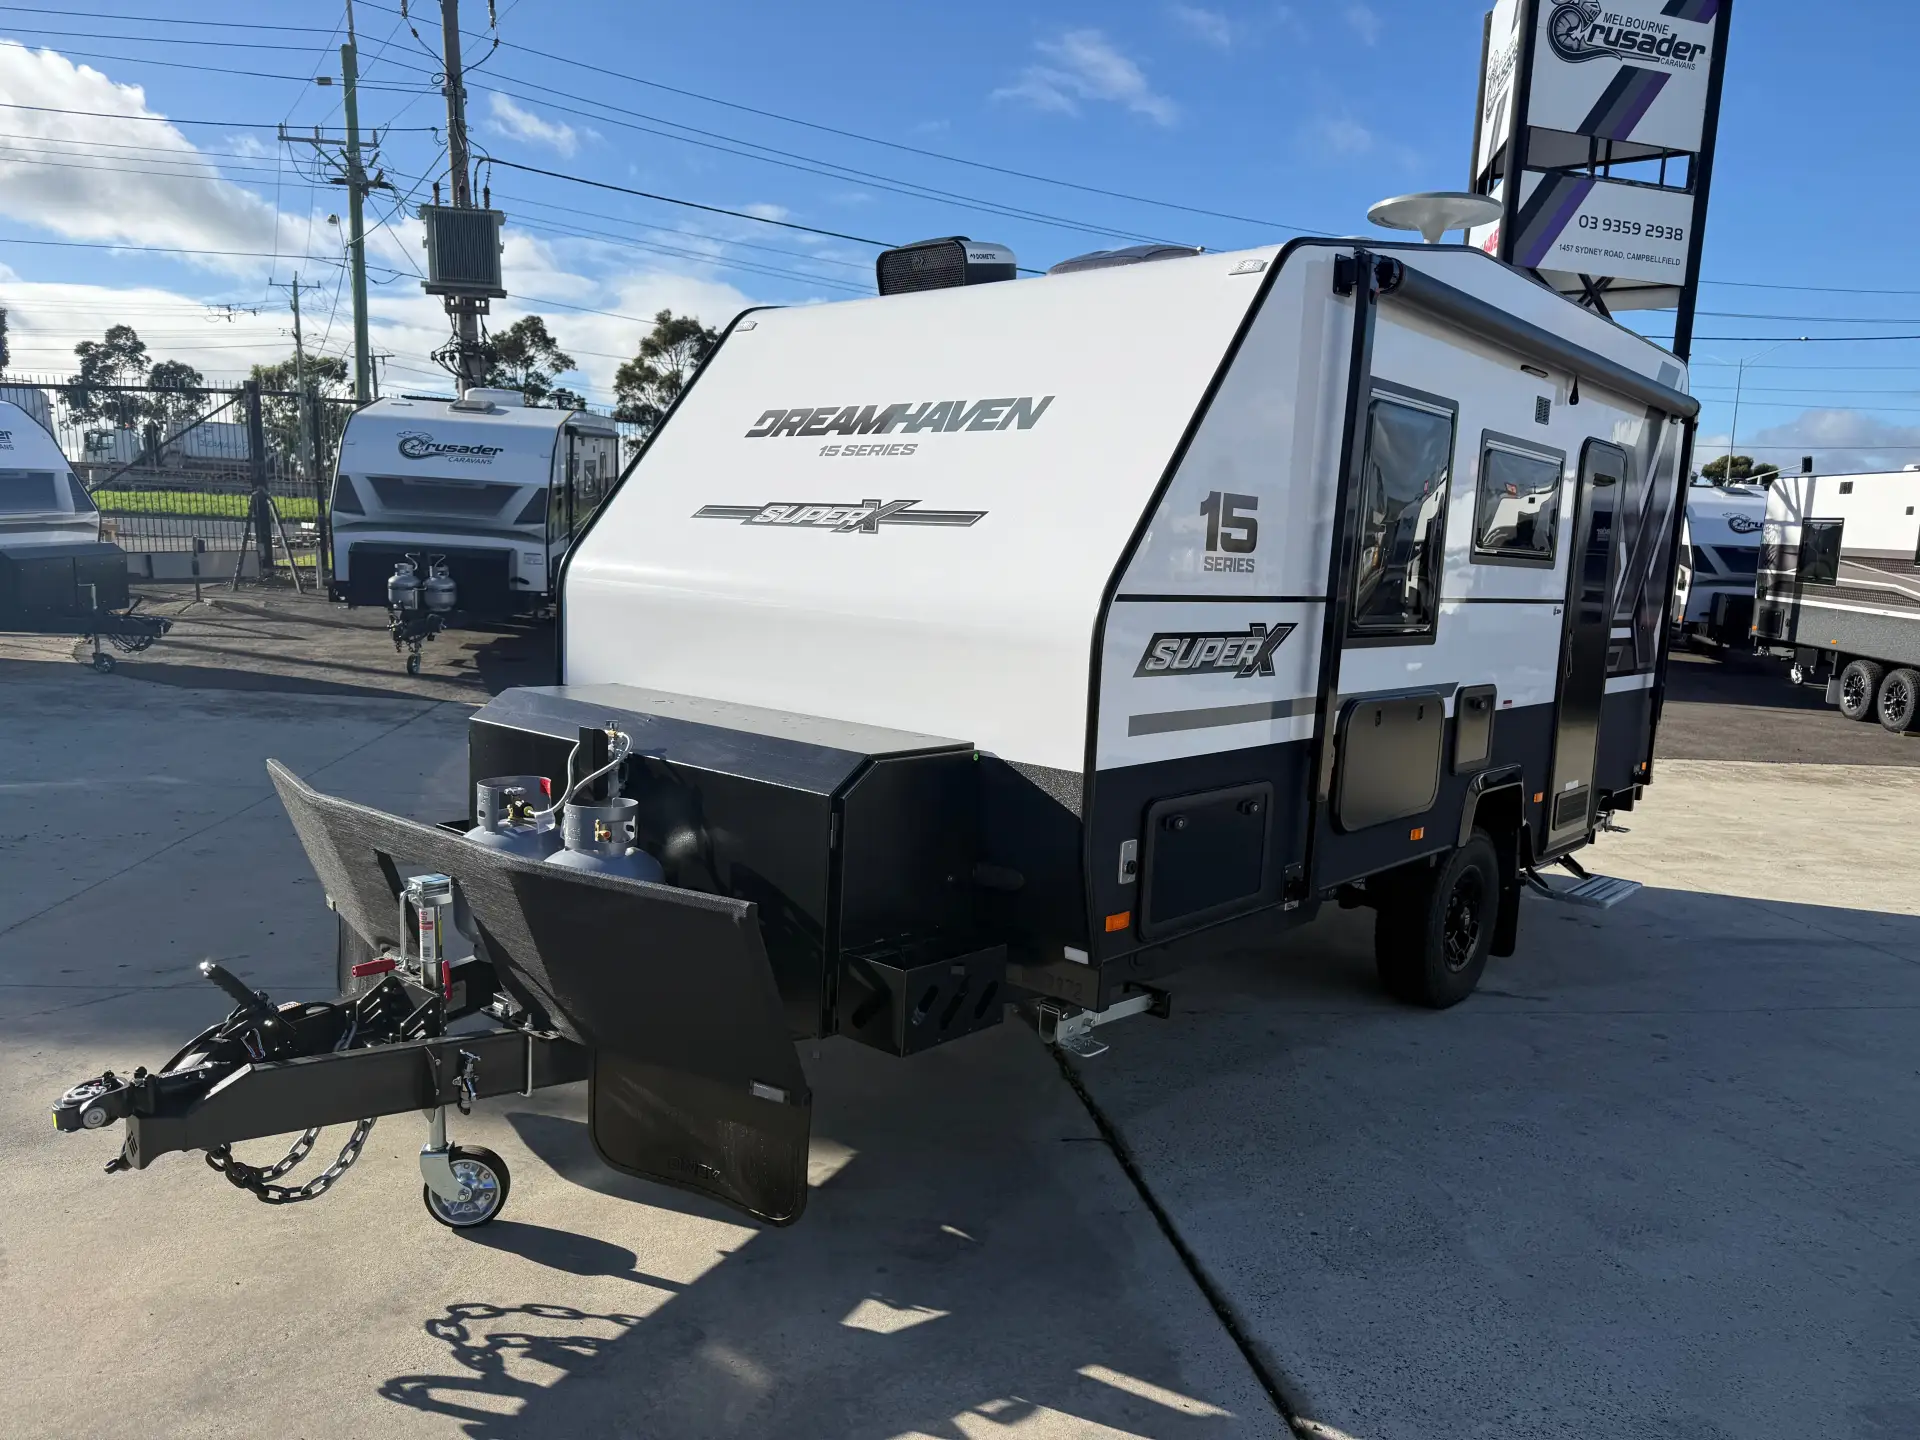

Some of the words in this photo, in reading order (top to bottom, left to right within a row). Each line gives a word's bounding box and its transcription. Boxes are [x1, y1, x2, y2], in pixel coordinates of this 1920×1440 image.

[1547, 3, 1706, 63] Crusader
[1603, 12, 1670, 36] MELBOURNE
[1660, 57, 1697, 71] CARAVANS
[1578, 214, 1599, 230] 03
[1602, 218, 1641, 236] 9359
[1645, 224, 1684, 241] 2938
[1558, 243, 1574, 252] 1457
[1575, 245, 1603, 256] SYDNEY
[1603, 249, 1625, 260] ROAD,
[1626, 252, 1681, 266] CAMPBELLFIELD
[744, 395, 1056, 438] DREAMHAVEN
[398, 436, 504, 460] Crusader
[819, 445, 842, 457] 15
[841, 443, 919, 457] SERIES
[448, 456, 493, 465] CARAVANS
[1200, 490, 1259, 553] 15
[1203, 555, 1255, 573] SERIES
